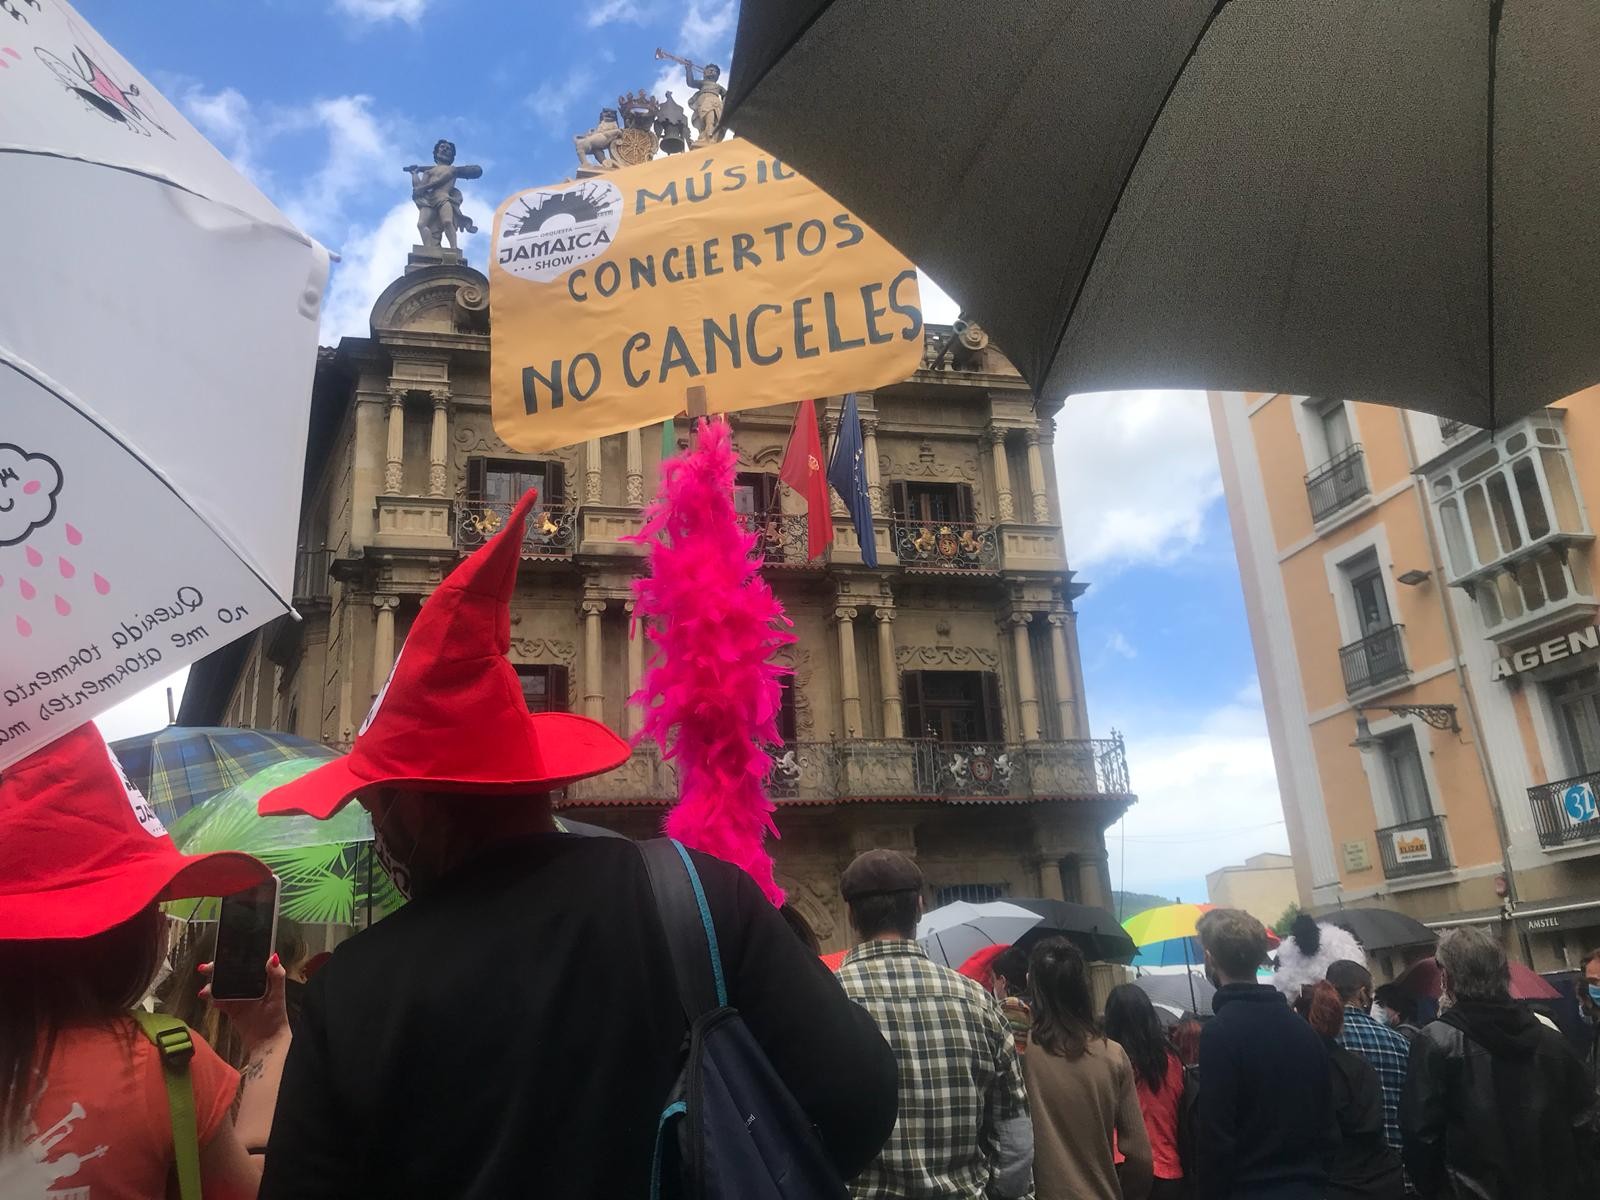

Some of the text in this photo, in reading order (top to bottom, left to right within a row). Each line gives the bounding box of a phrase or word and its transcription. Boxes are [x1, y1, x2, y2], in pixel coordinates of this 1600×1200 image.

[499, 230, 611, 265] JAMAICA
[535, 255, 574, 270] SHOW
[568, 213, 864, 302] CONCIERTOS
[522, 270, 923, 415] NO CANCELES
[1528, 917, 1559, 929] AMSTEL
